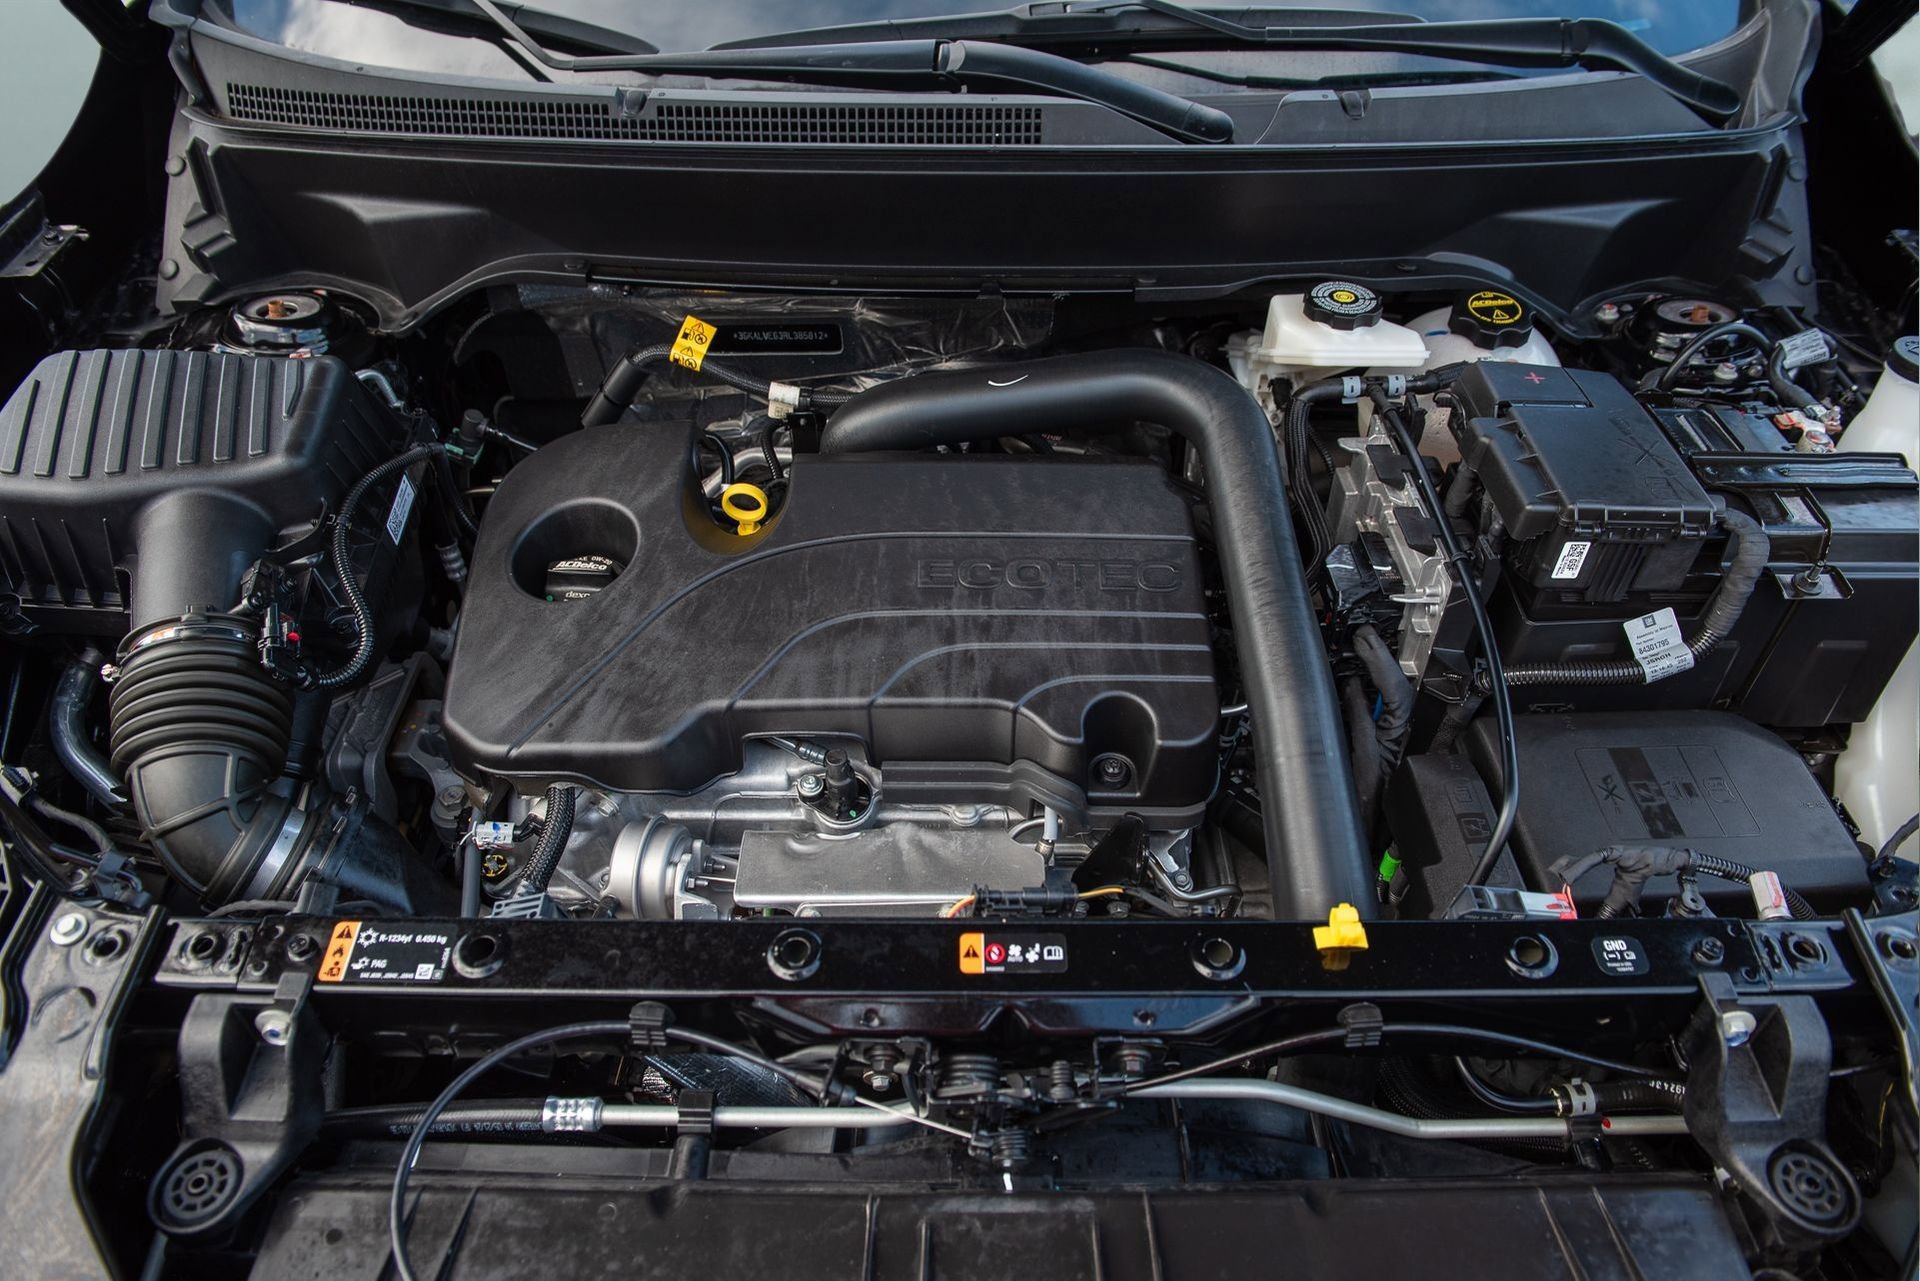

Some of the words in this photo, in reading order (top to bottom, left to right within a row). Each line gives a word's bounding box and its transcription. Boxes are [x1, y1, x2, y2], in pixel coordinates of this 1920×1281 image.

[555, 560, 608, 571] ACDelco
[917, 559, 1184, 592] ECOTEC
[379, 934, 413, 944] R-1234yf
[415, 935, 436, 943] 0.450
[436, 936, 448, 945] kg
[1602, 939, 1628, 951] GND
[370, 959, 388, 969] PAG
